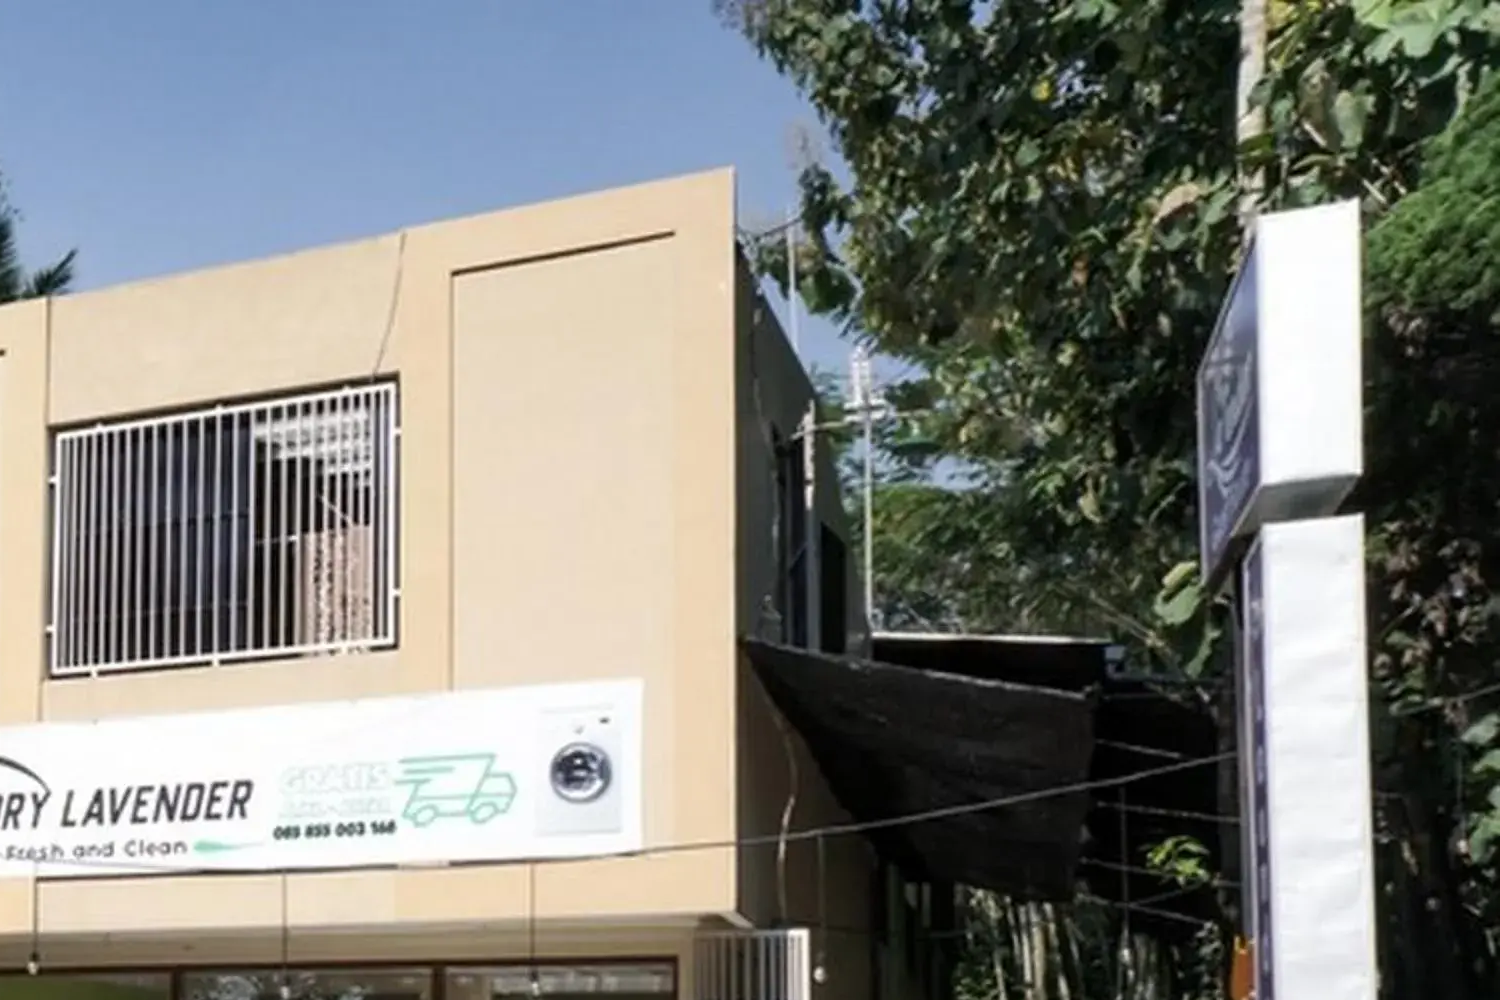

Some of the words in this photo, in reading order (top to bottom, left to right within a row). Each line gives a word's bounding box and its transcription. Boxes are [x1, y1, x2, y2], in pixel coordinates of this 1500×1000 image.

[60, 779, 254, 828] LAVENDER
[72, 841, 116, 859] and
[123, 839, 189, 858] Clean
